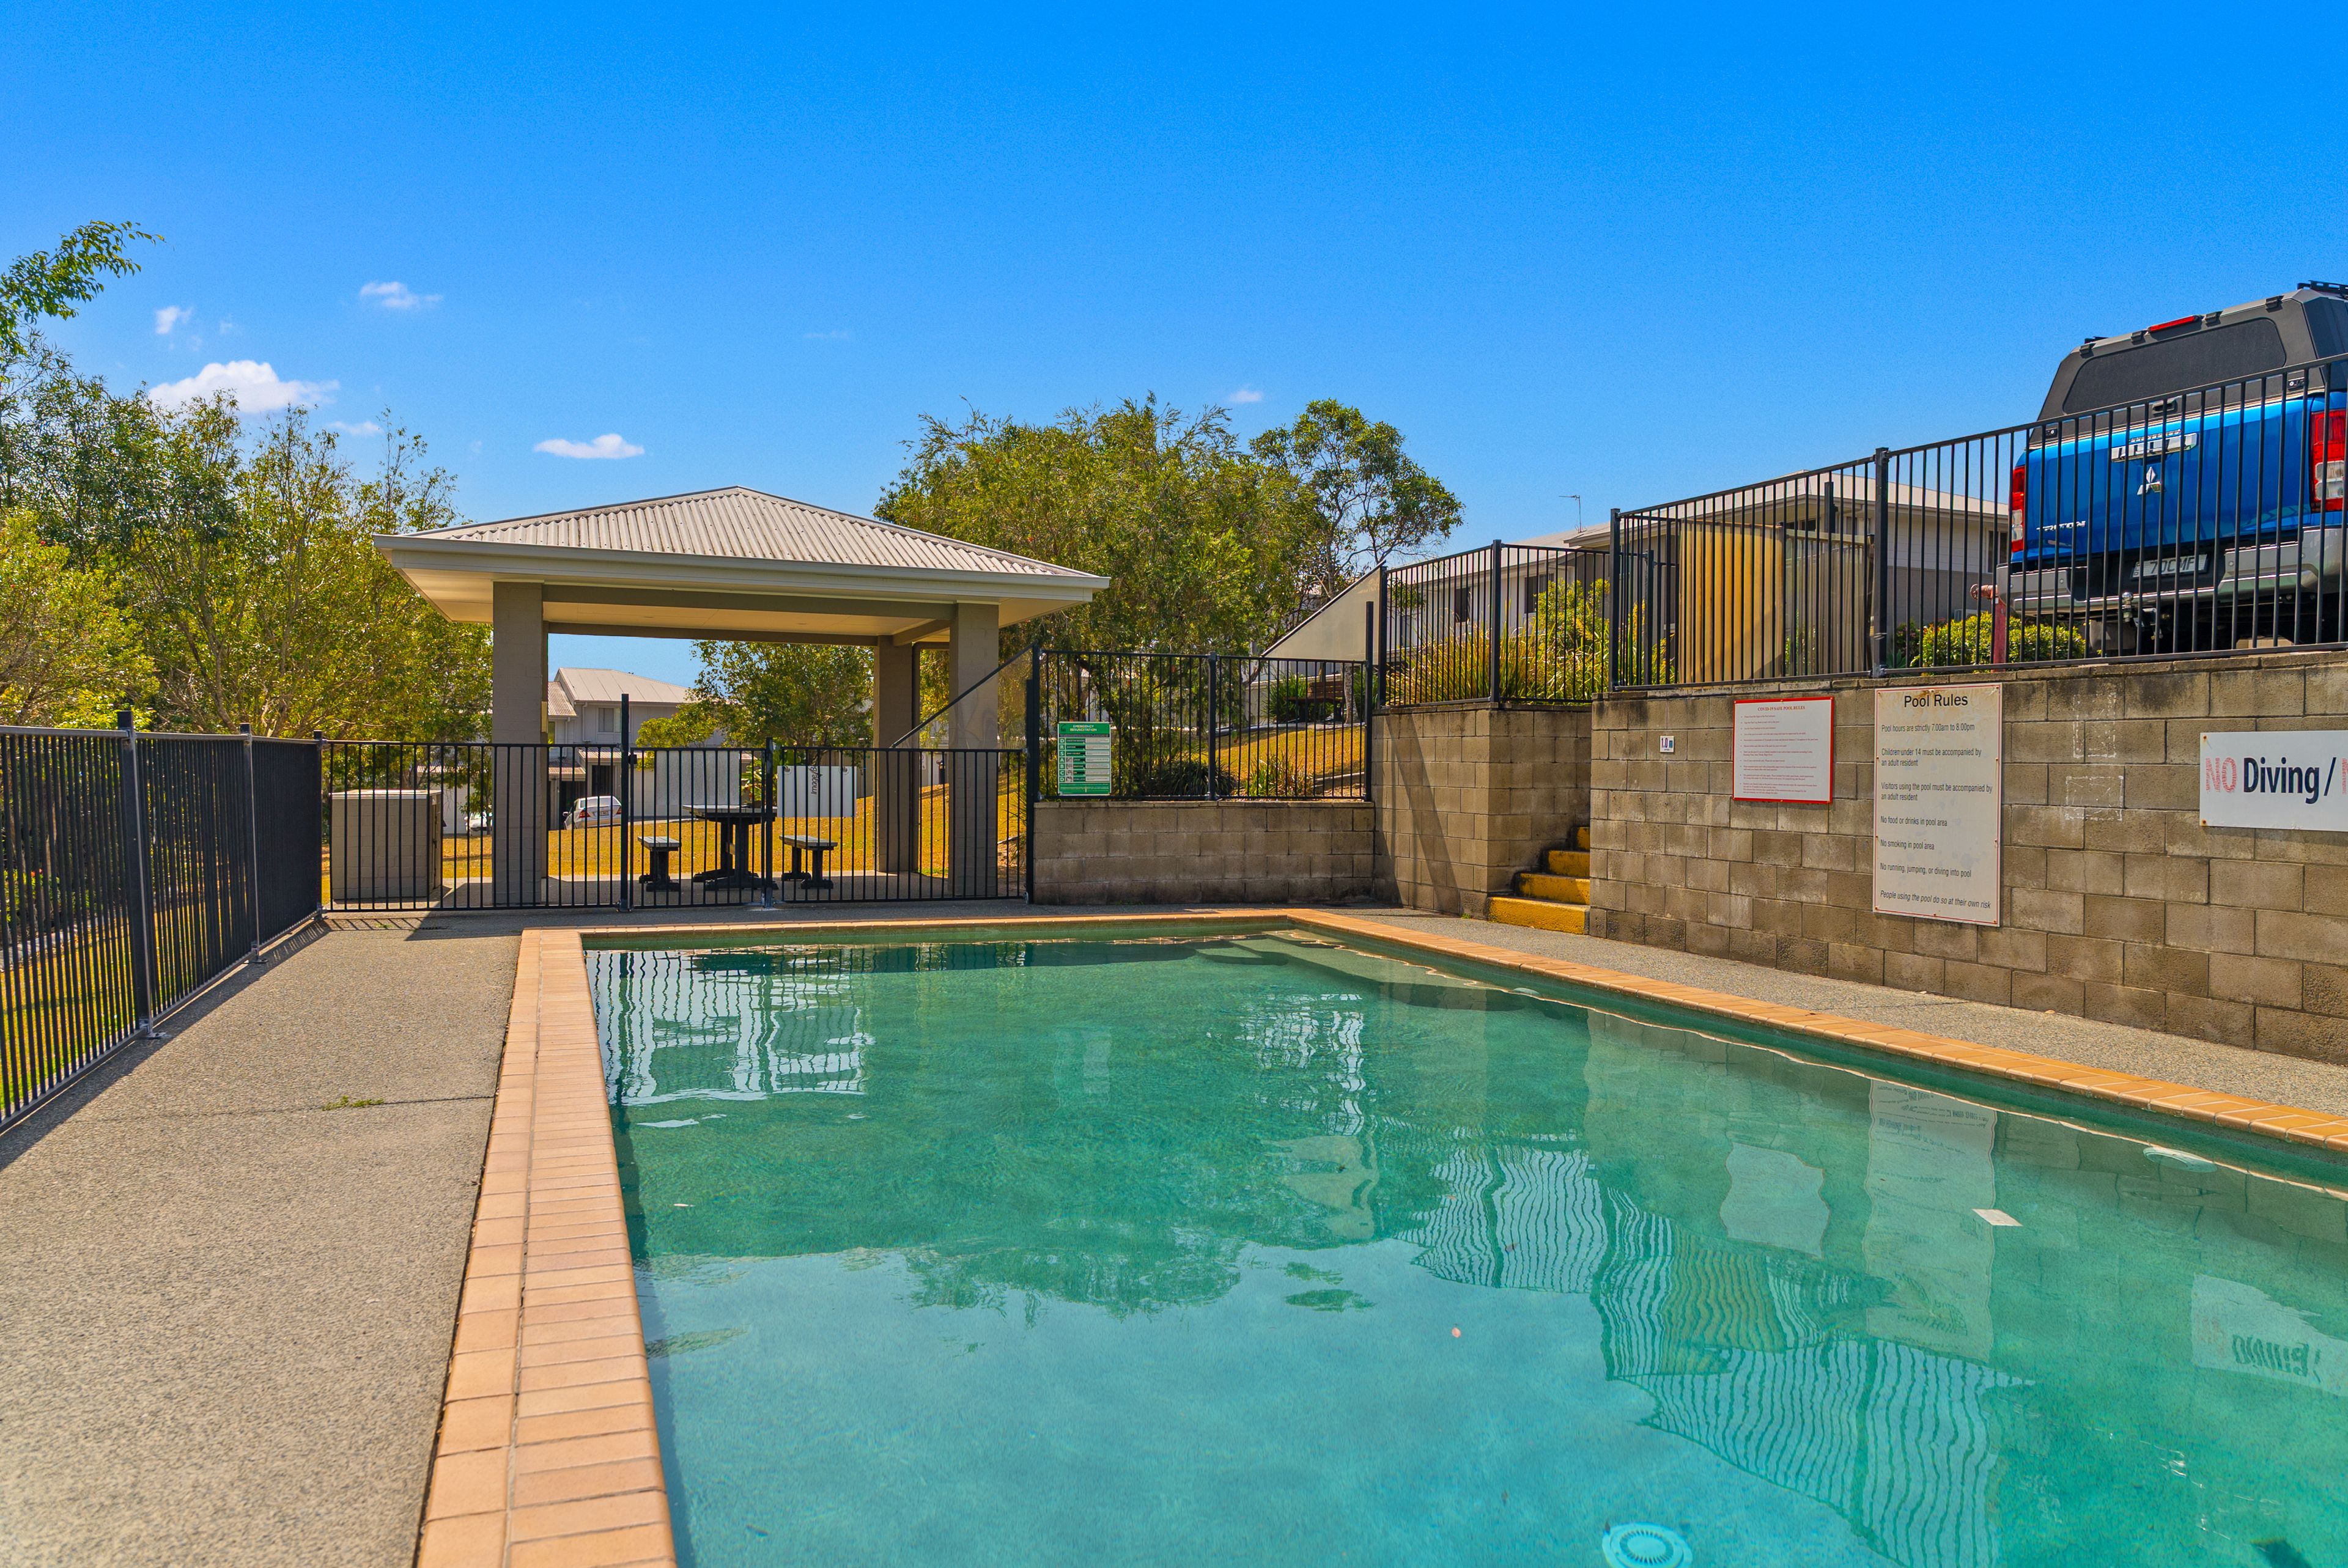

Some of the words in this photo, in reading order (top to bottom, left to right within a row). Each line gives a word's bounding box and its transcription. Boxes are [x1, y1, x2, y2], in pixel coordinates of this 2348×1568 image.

[1904, 694, 1930, 708] Pool
[1933, 693, 1968, 707] Rules
[1914, 724, 1930, 733] strictly
[1956, 723, 1975, 732] 8.00pm
[1942, 748, 1974, 757] accompanied
[1975, 748, 1982, 757] by
[2206, 757, 2237, 793] NO
[2243, 756, 2320, 804] Diving
[1899, 782, 1911, 792] using
[1921, 783, 1931, 792] pool
[1952, 784, 1985, 793] accompanied
[1987, 784, 1993, 793] by
[1888, 841, 1907, 850] smoking
[1913, 842, 1924, 850] pool
[1888, 864, 1906, 874] running,
[1907, 865, 1927, 875] jumping,
[1934, 867, 1949, 877] diving
[1950, 868, 1960, 877] into
[1880, 890, 1897, 900] People
[1897, 893, 1911, 902] using
[1954, 898, 1967, 907] their
